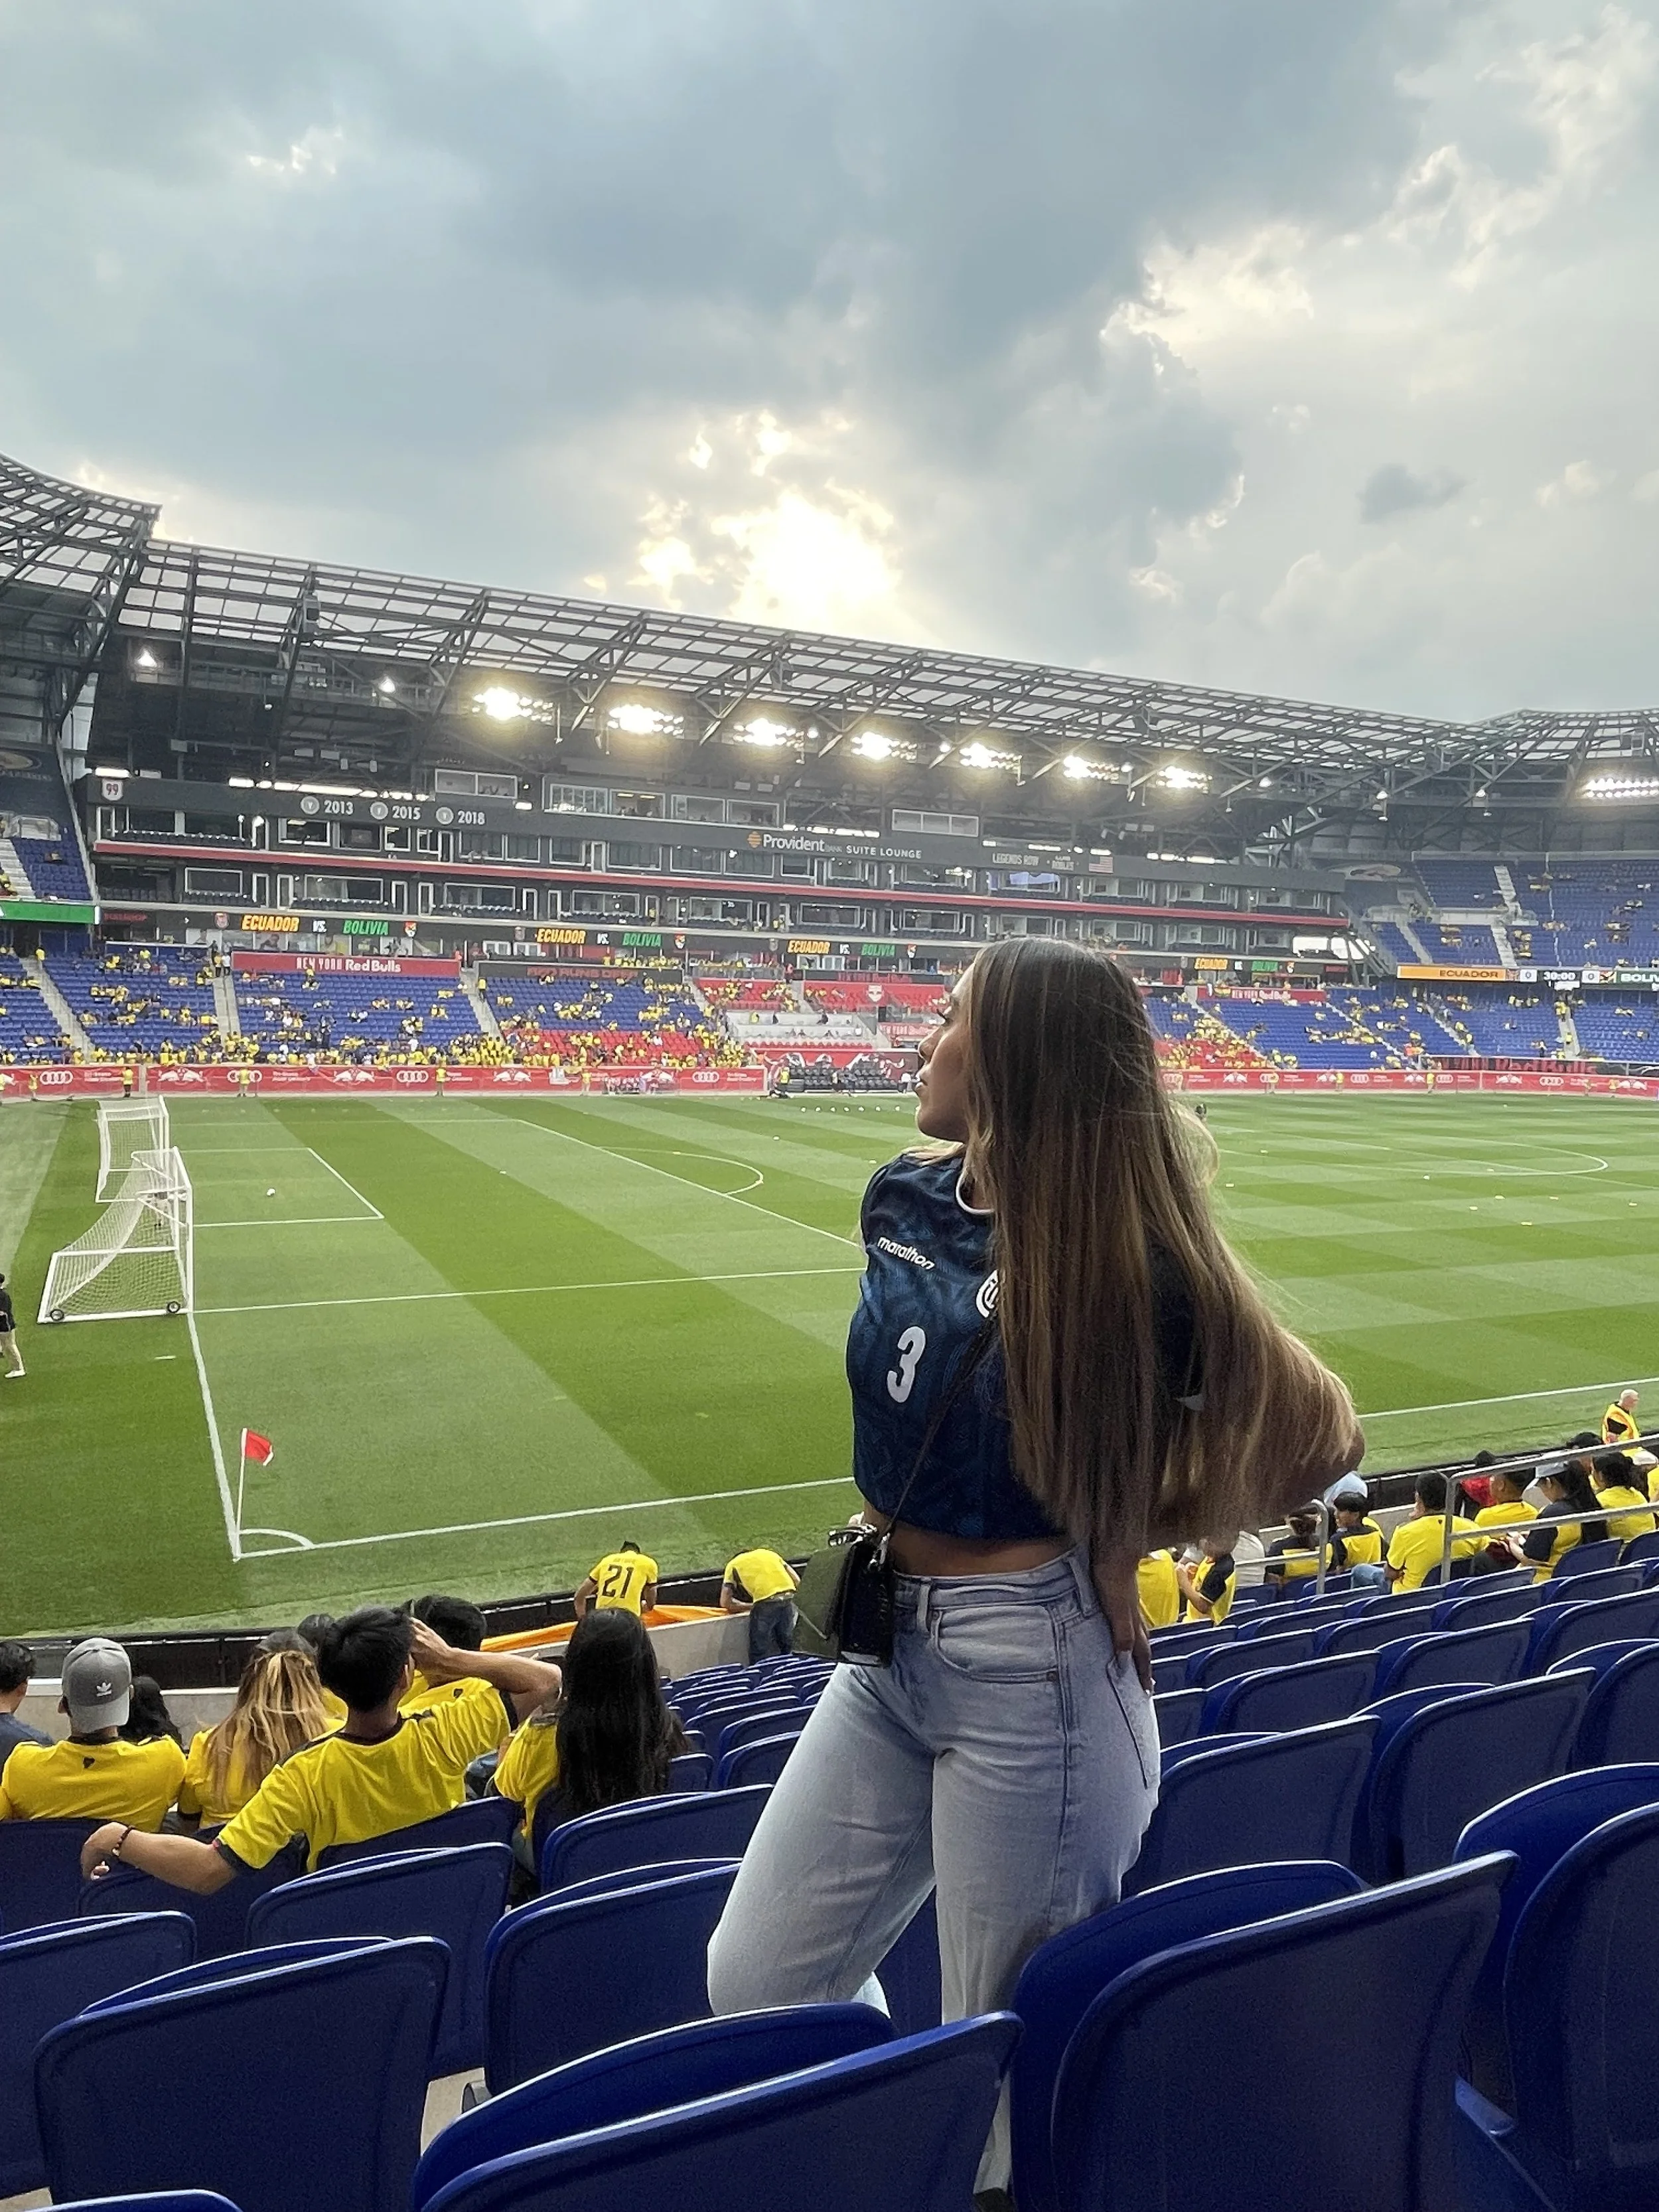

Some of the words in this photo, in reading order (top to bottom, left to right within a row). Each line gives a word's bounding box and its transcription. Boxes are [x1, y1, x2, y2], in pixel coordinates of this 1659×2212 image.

[324, 800, 354, 815] 2013
[392, 805, 421, 820] 2015
[458, 810, 486, 825] 2018
[763, 834, 825, 852] Provident
[846, 845, 877, 856] SUITE
[880, 848, 922, 859] LOUNGE
[242, 915, 299, 932] ECUADOR
[342, 920, 389, 935] BOLIVIA
[537, 928, 586, 944] ECUADOR
[622, 932, 661, 947] BOLIVIA
[787, 940, 831, 954] ECUADOR
[861, 943, 896, 957] BOLIVIA
[345, 958, 370, 972] Red
[371, 960, 401, 972] Bulls
[1543, 971, 1576, 981] 30:00
[877, 1236, 935, 1270] marathon
[887, 1326, 926, 1403] 3
[602, 1564, 634, 1598] 21
